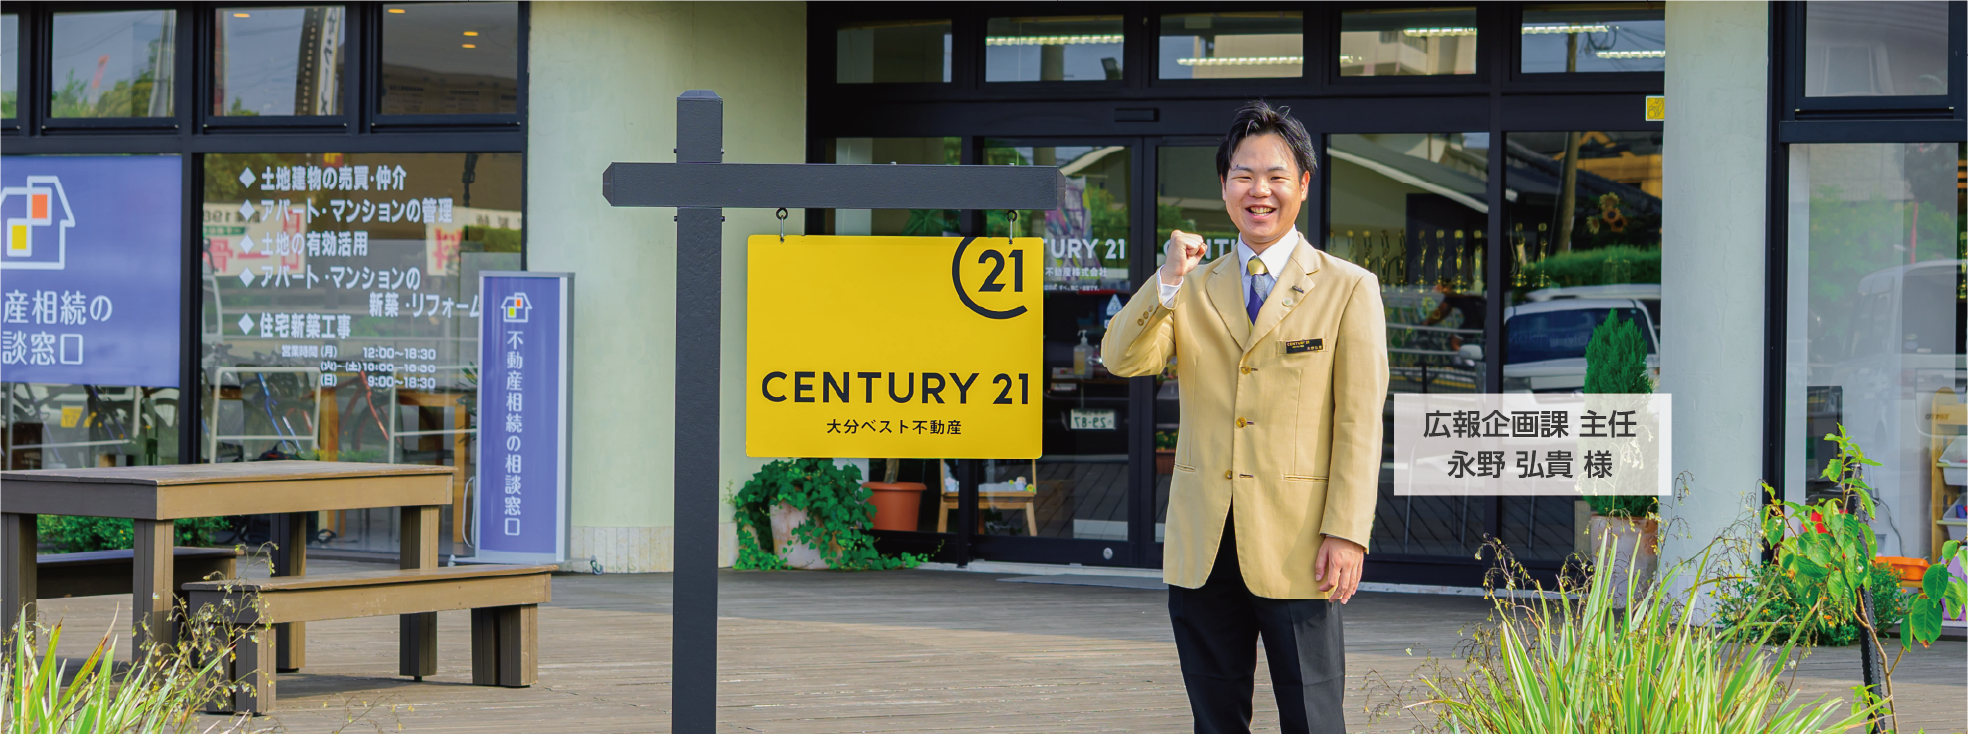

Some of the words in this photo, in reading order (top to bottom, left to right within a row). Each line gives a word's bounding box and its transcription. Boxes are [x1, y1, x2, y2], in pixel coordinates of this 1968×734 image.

[260, 165, 407, 191] 土地建物の売買・仲介
[260, 197, 453, 224] アパート・マンションの管理
[260, 231, 369, 257] 土地の有効活用
[1104, 238, 1126, 259] 21
[260, 264, 421, 291] アパート・マンションの
[3, 289, 113, 326] 産相続の
[259, 312, 352, 339] 住宅新築工事
[2, 330, 84, 366] 談窓口
[761, 371, 980, 404] CENTURY
[992, 373, 1029, 405] 21
[504, 330, 524, 536] 不動産相続の相談窓口
[826, 418, 962, 435] 大分ベスト不動産
